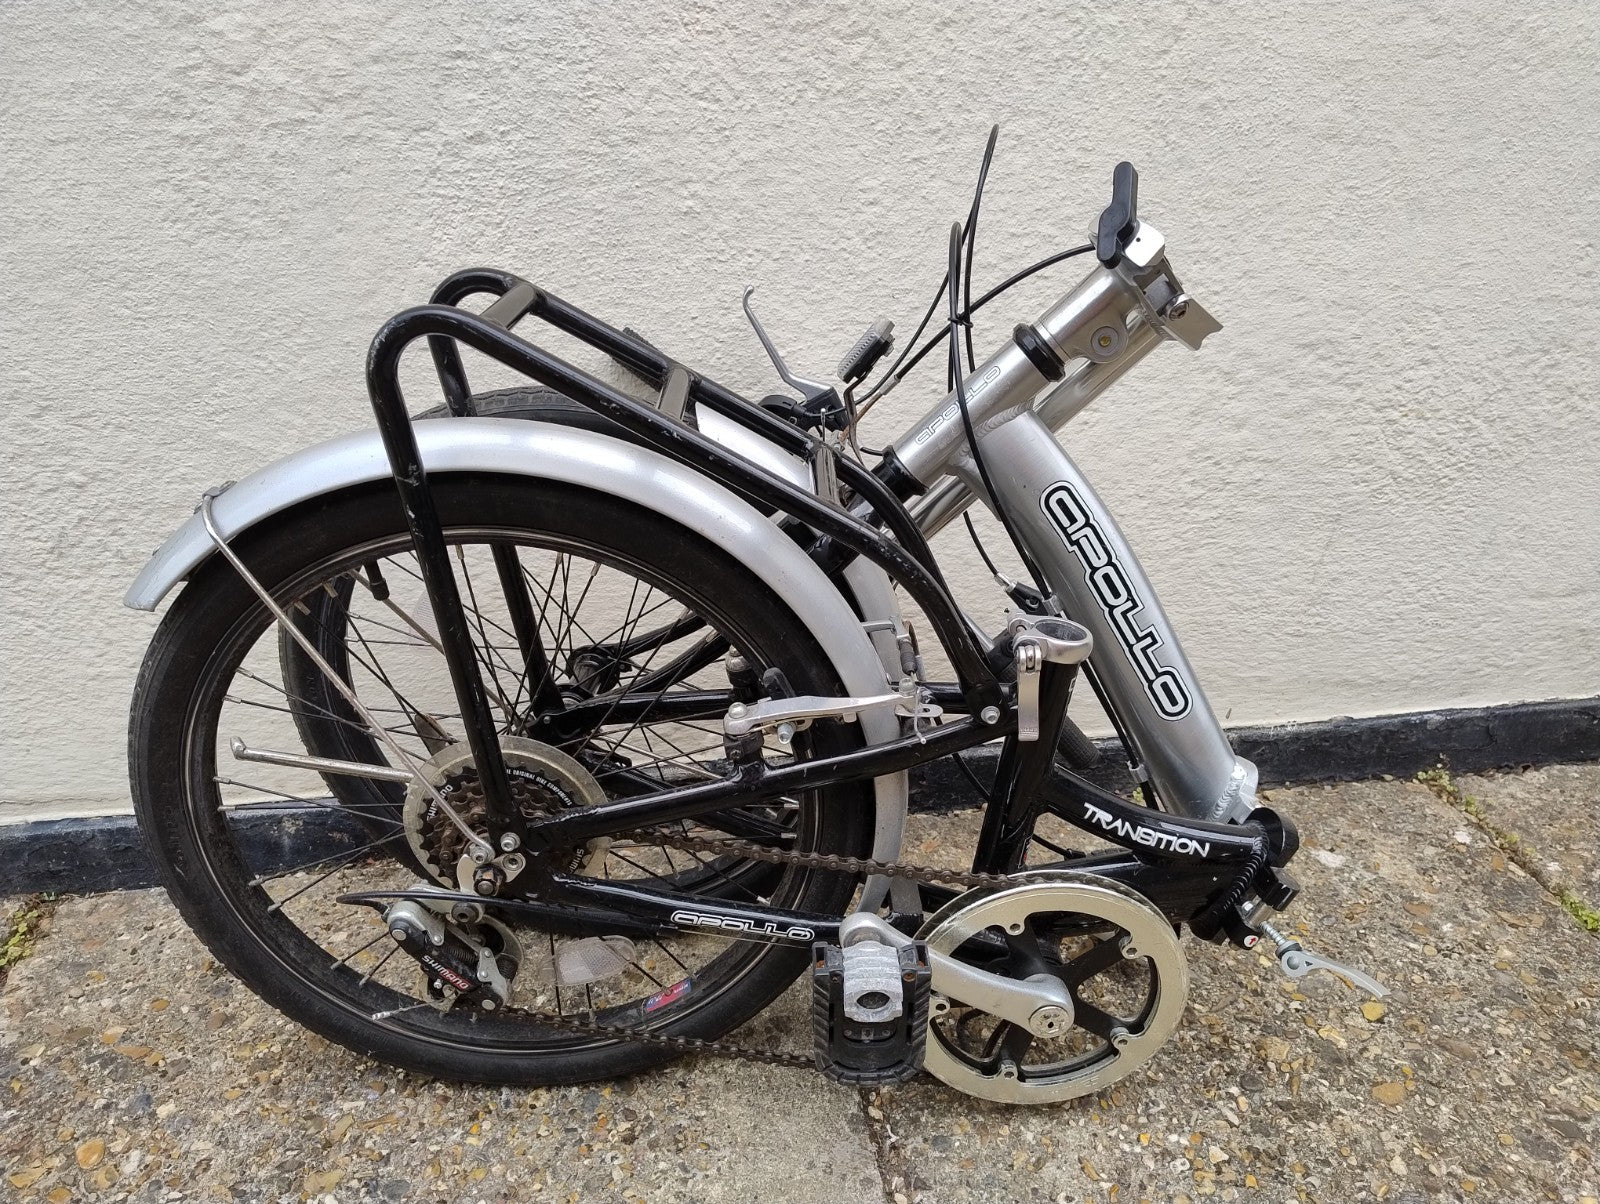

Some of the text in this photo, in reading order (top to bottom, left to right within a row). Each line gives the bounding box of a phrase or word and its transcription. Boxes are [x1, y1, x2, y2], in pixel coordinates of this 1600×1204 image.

[1039, 480, 1193, 722] APOLLO
[1083, 801, 1211, 858] TRANSITION
[670, 909, 816, 941] APOLLO
[421, 955, 469, 990] SHIMANO
